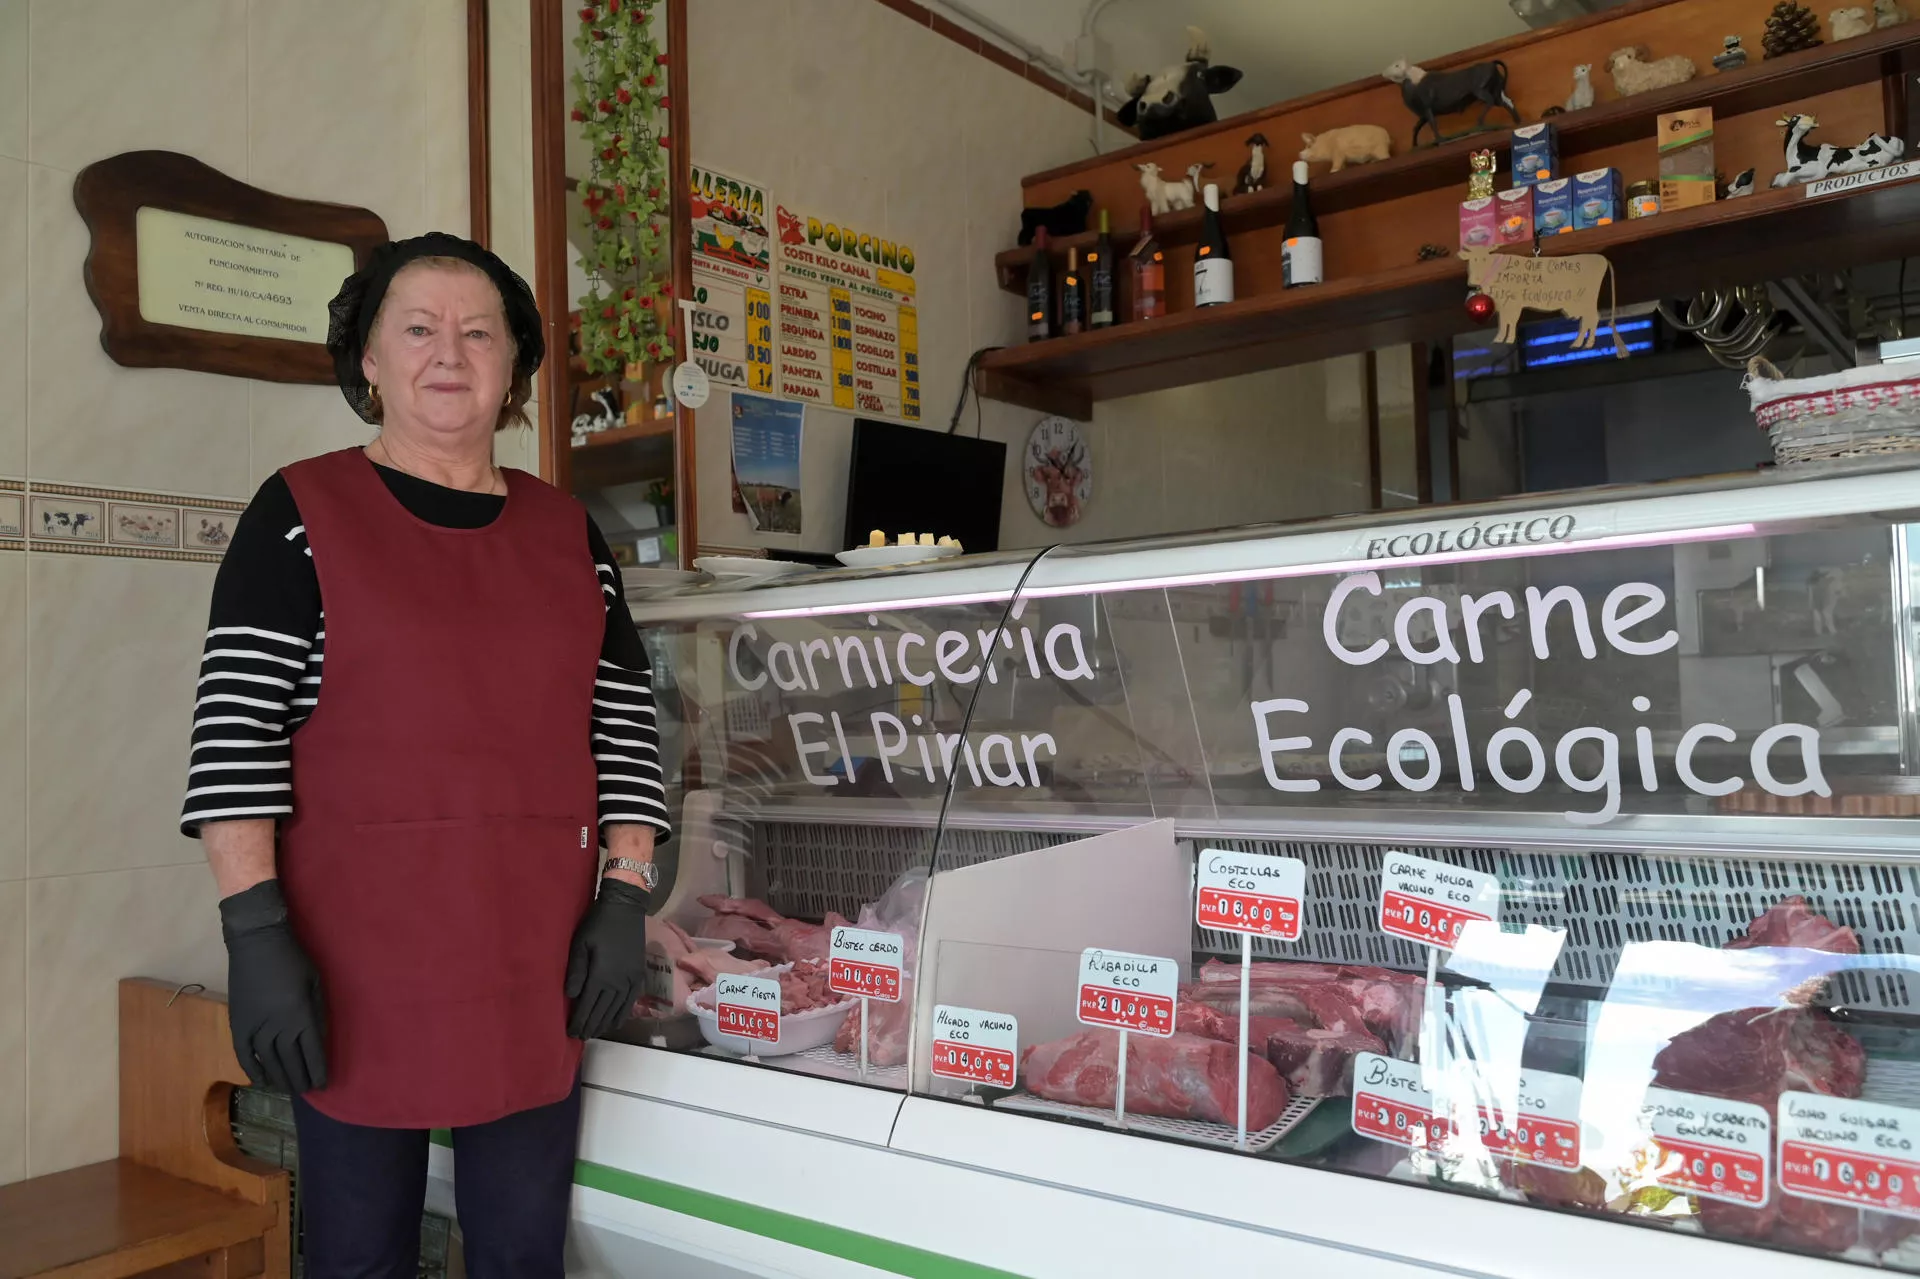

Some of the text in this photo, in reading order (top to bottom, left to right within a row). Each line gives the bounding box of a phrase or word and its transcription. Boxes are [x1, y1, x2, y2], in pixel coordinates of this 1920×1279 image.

[1814, 164, 1910, 193] PRODUCTOS
[246, 244, 286, 259] SANITARIA
[290, 254, 301, 262] DE
[807, 216, 915, 274] PORCINO
[209, 257, 279, 279] FUNCIONAMIENTO
[712, 263, 720, 272] AL
[784, 246, 871, 280] COSTE KILO CANAL
[1524, 259, 1541, 270] QUE
[785, 264, 817, 279] PRECIO
[820, 274, 845, 287] VENTA
[848, 282, 858, 290] AL
[780, 284, 808, 300] EXTRA
[178, 303, 307, 334] VENTA DIRECTA AL CONSUMIDOR
[780, 303, 820, 321] PRIMERA
[854, 306, 886, 323] TOCINO
[781, 322, 825, 341] SEGUNDA
[855, 324, 896, 342] ESPINAZO
[855, 342, 895, 360] CODILLOS
[782, 363, 823, 381] PANCETA
[856, 361, 897, 378] COSTILLAR
[783, 382, 820, 398] PAPADA
[856, 378, 874, 390] PIES
[1054, 423, 1063, 434] 12
[1366, 514, 1577, 560] ECOLÓGICO
[1322, 570, 1680, 665] Carne
[728, 599, 1094, 691] Carnicería
[788, 711, 1057, 788] El Pinar
[1251, 688, 1832, 825] Ecológica
[1209, 856, 1281, 877] COSTILLAS
[1389, 863, 1474, 888] CARNE MOLIDA
[1228, 878, 1255, 890] ECO
[1398, 882, 1471, 903] VACUNO ECO
[869, 942, 898, 954] CERDO
[718, 980, 748, 994] CARNE
[1112, 976, 1140, 987] ECO
[979, 1020, 1013, 1031] VACUNO
[949, 1030, 970, 1040] ECO
[1788, 1100, 1827, 1120] LOMO
[1676, 1123, 1747, 1144] ENCARGO
[1797, 1127, 1912, 1150] VACUNO ECO
